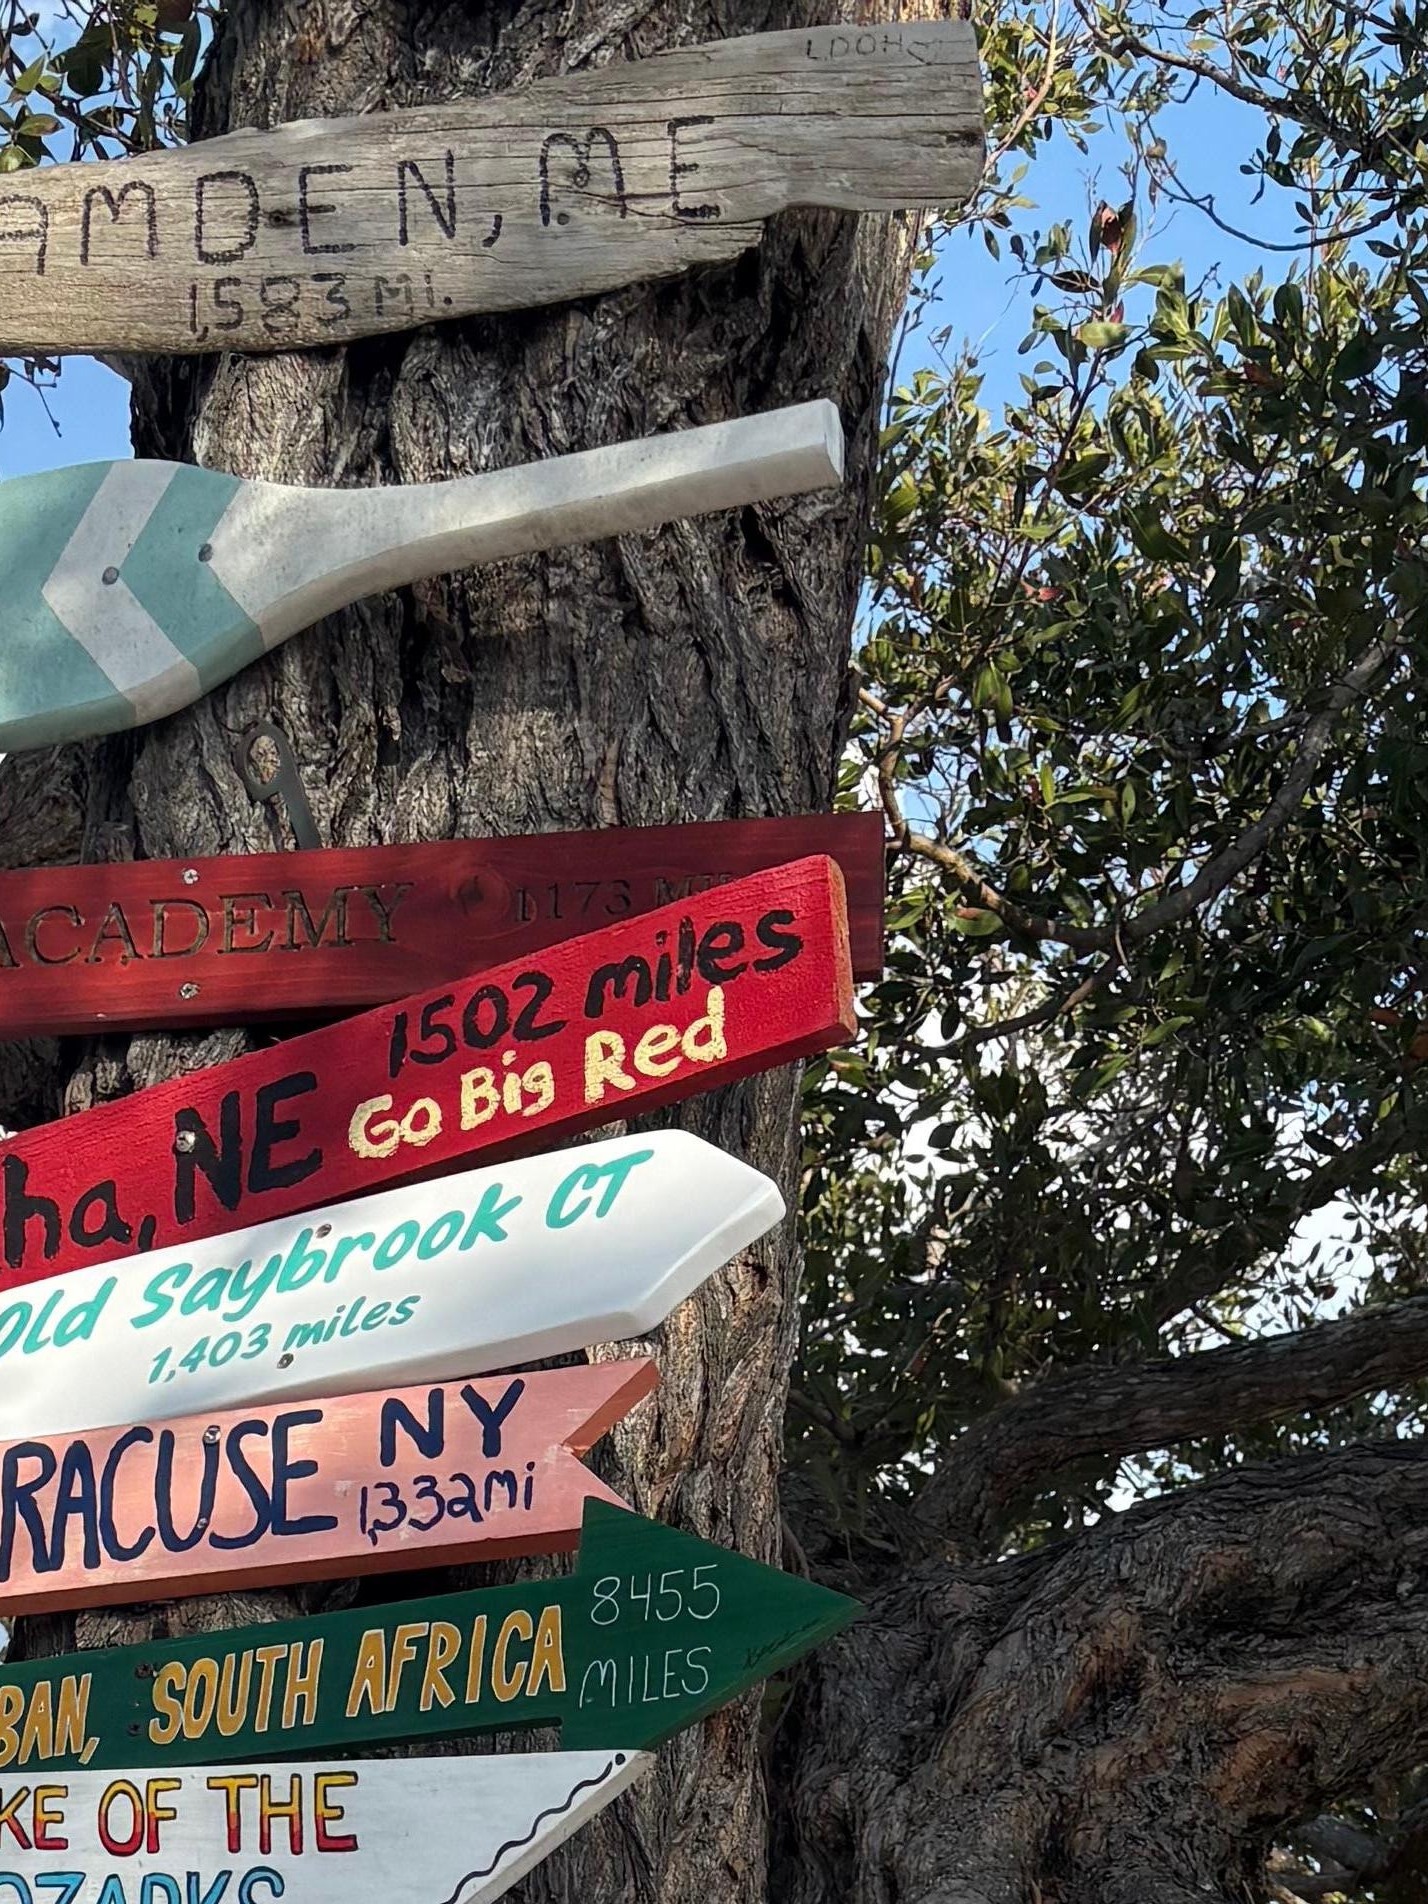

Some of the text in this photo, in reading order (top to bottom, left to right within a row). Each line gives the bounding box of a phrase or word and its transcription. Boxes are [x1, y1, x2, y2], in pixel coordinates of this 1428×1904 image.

[188, 272, 352, 342] 1,583
[513, 879, 632, 923] 1173
[388, 909, 805, 1078] 1502 miles
[348, 985, 728, 1160] Go Big Red
[173, 1070, 324, 1224] NE
[130, 1182, 524, 1330] Saybrook
[544, 1148, 655, 1231] CT
[148, 1293, 422, 1385] 1,403 miles
[379, 1377, 526, 1467] NY
[590, 1564, 722, 1626] 8455
[147, 1637, 325, 1747] SOUTH
[345, 1604, 568, 1719] AFRICA
[578, 1645, 711, 1709] MILES
[98, 1776, 178, 1857] OF
[207, 1770, 361, 1856] THE
